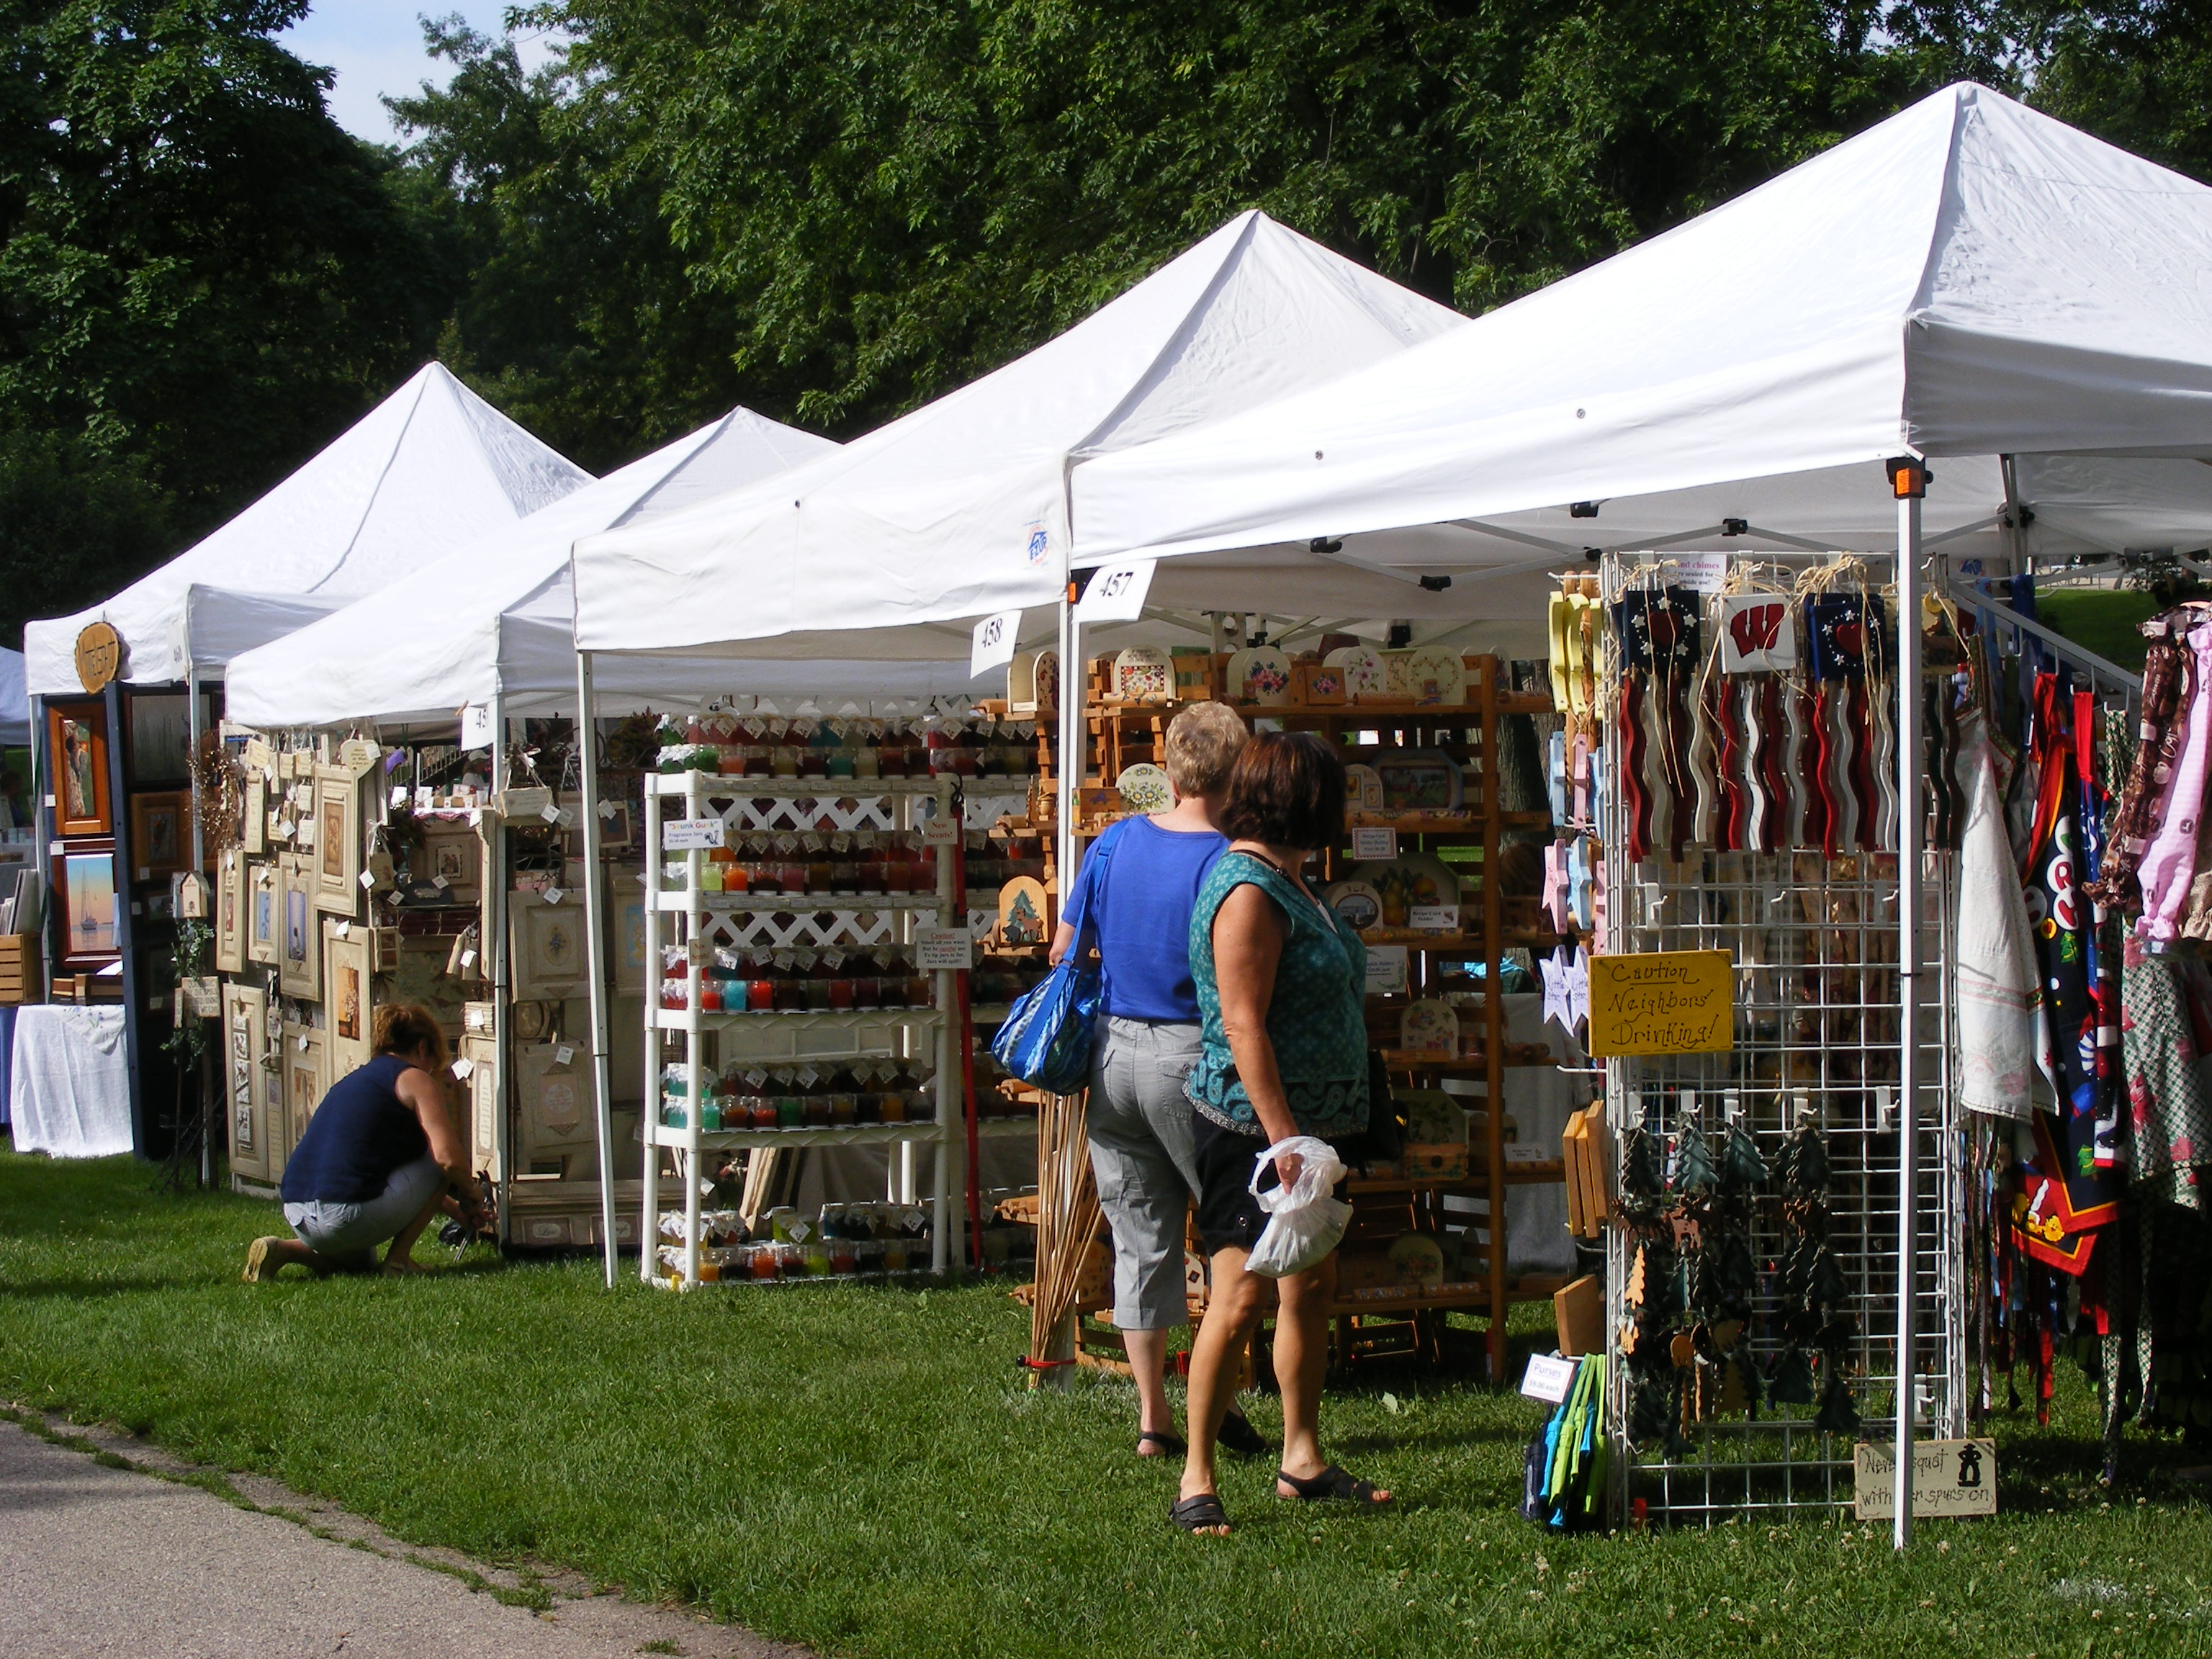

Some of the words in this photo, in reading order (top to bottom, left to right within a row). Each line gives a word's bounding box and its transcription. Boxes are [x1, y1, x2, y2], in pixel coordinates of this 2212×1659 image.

[1100, 571, 1135, 598] 457
[981, 617, 1003, 648] 458
[1730, 603, 1784, 658] W
[1611, 961, 1700, 984] Caution
[1611, 1014, 1719, 1049] Drinking!
[1533, 1362, 1563, 1377] Purses
[1864, 1452, 1895, 1474] Neve
[1861, 1486, 1892, 1507] with
[1925, 1488, 1965, 1508] spurs
[1969, 1488, 1990, 1502] on
